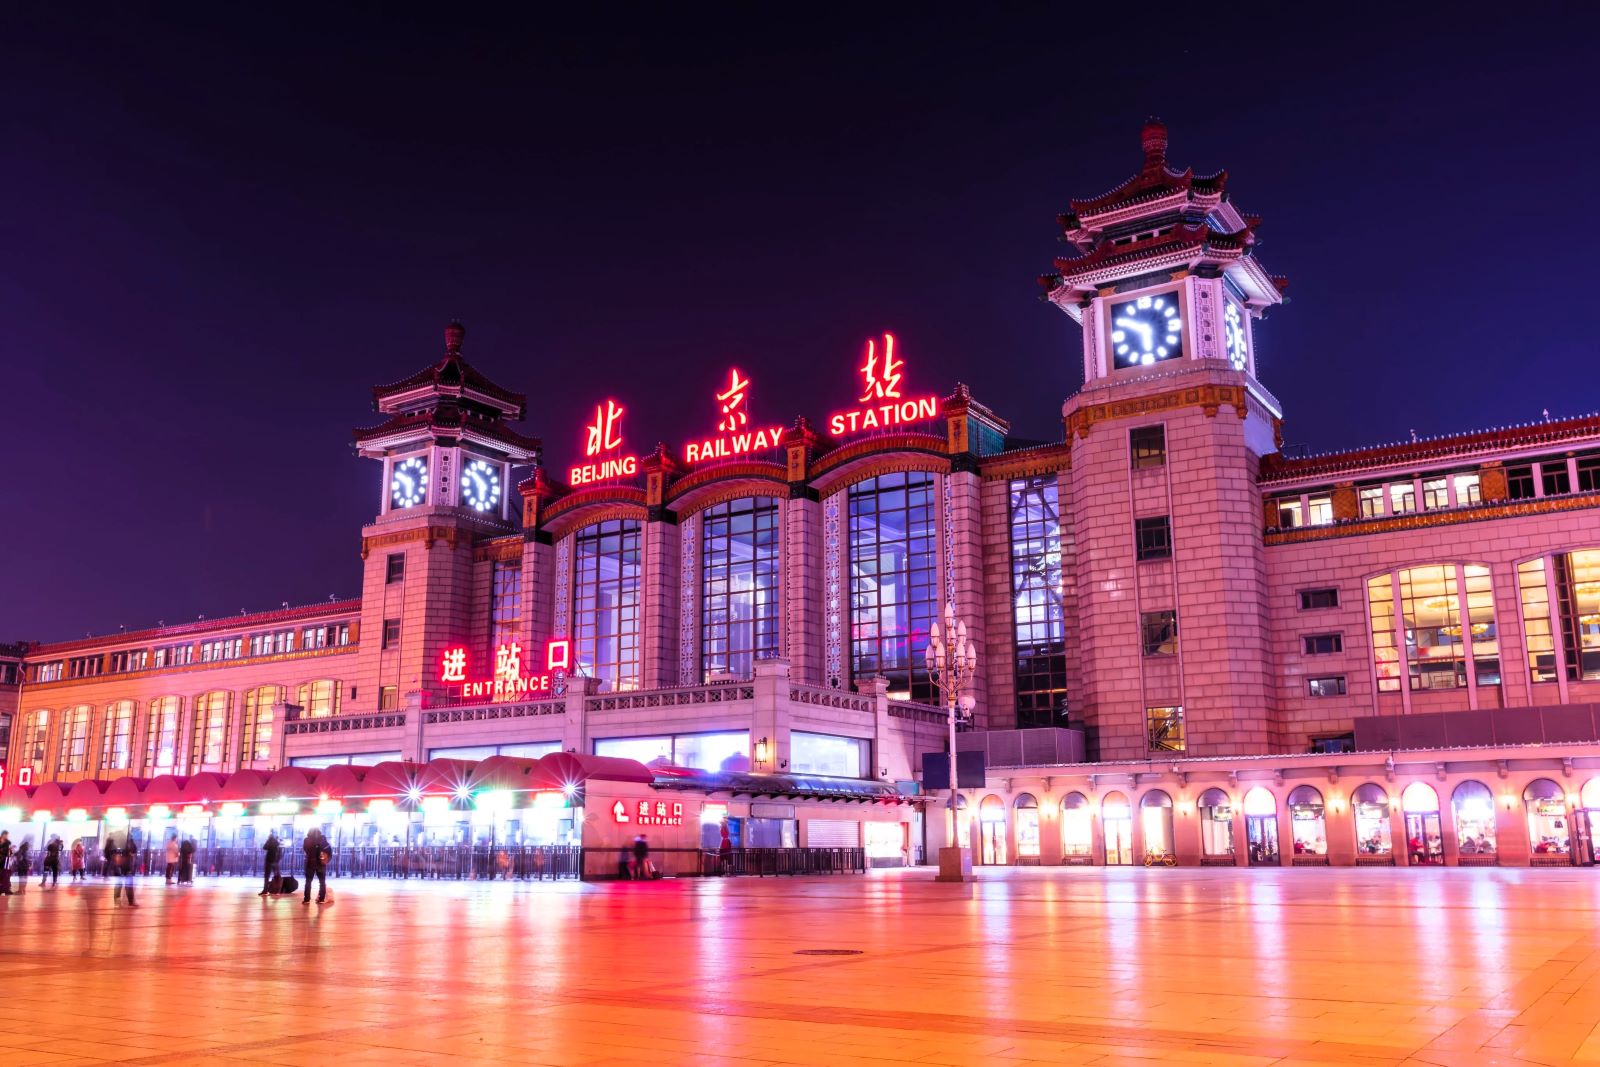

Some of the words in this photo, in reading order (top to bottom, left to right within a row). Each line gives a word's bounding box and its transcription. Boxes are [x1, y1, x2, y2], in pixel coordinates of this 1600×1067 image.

[571, 455, 637, 486] BEIJING
[686, 427, 783, 463] RAILWAY
[831, 396, 937, 435] STATION
[463, 675, 549, 697] ENTRANCE
[639, 801, 682, 816] 进站口
[638, 816, 682, 825] ENTRANCE
